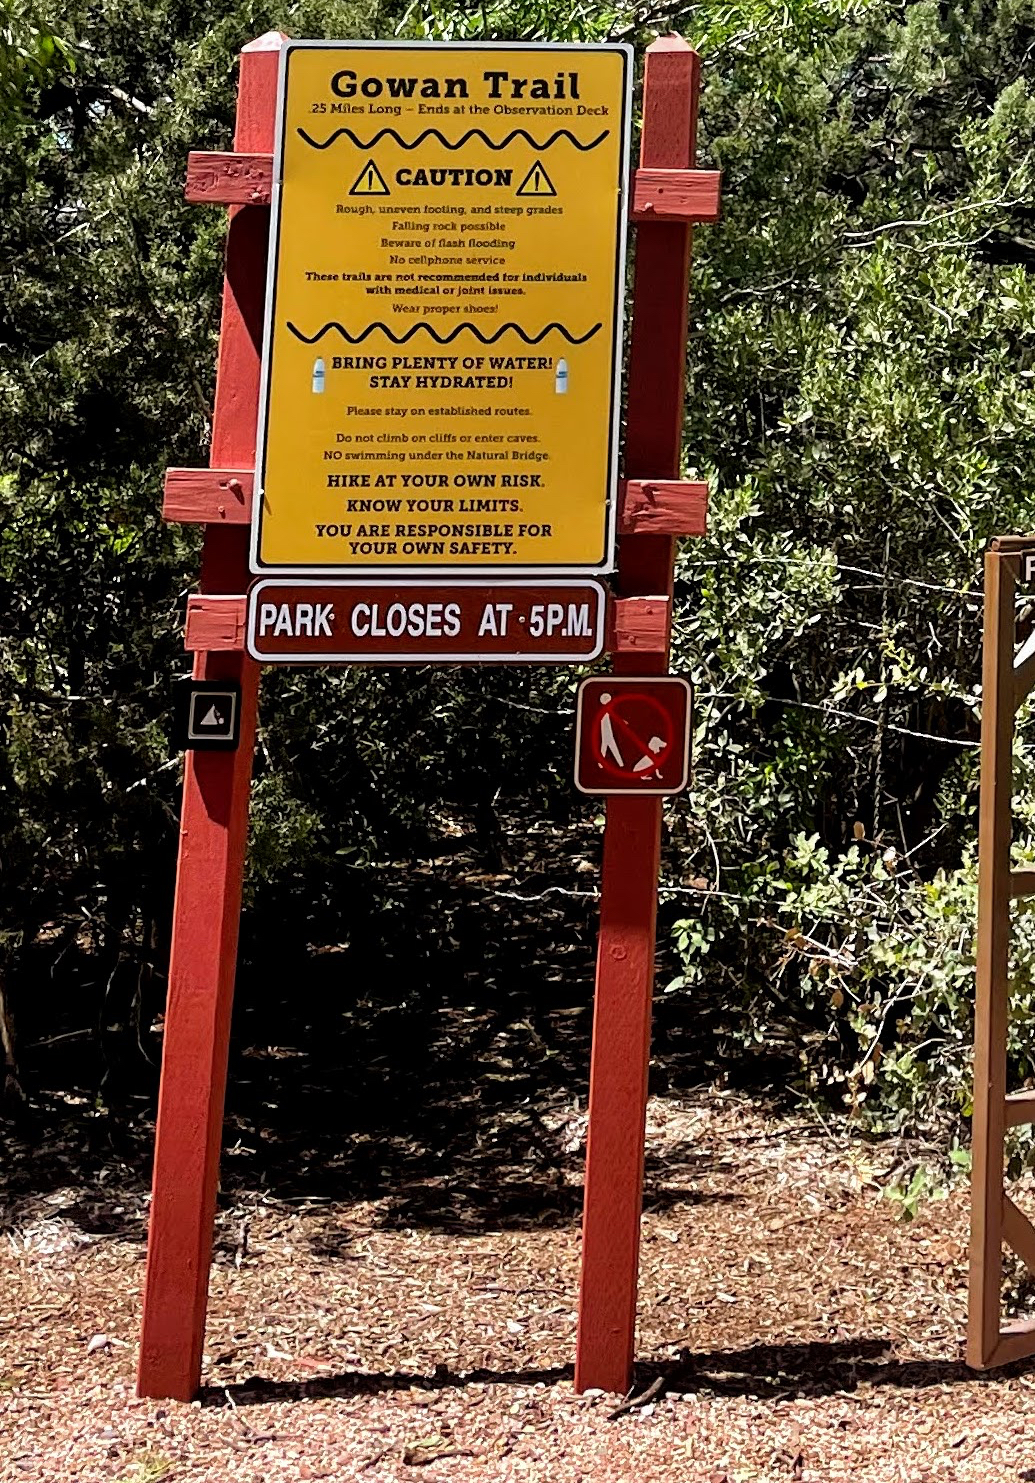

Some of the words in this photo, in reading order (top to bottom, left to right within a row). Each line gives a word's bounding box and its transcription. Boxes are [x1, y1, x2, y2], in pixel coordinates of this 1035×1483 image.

[331, 70, 468, 99] Gowan
[483, 72, 580, 99] Trail
[330, 102, 364, 114] Miles
[368, 103, 401, 117] Long
[418, 103, 449, 115] Ends
[453, 104, 466, 115] at
[469, 103, 490, 115] the
[494, 104, 573, 116] Observation
[576, 104, 609, 116] Deck
[396, 169, 513, 186] CAUTION
[336, 204, 375, 216] Rough,
[379, 206, 420, 215] uneven
[424, 204, 467, 217] footing,
[471, 204, 491, 215] and
[495, 205, 523, 217] steep
[526, 204, 563, 217] grades
[392, 220, 430, 233] Falling
[433, 221, 457, 231] rock
[460, 221, 506, 234] possible
[381, 237, 421, 248] Beware
[424, 238, 436, 248] of
[439, 238, 465, 248] flash
[468, 238, 515, 251] flooding
[390, 254, 405, 265] No
[408, 254, 463, 267] cellphone
[466, 255, 505, 265] service
[306, 271, 338, 282] These
[342, 271, 371, 282] trails
[375, 274, 392, 282] are
[395, 272, 415, 282] not
[418, 272, 499, 282] recommended
[502, 272, 519, 282] for
[522, 272, 587, 282] individuals
[366, 285, 391, 295] with
[394, 285, 440, 295] medical
[443, 287, 454, 295] or
[457, 285, 485, 298] joint
[488, 285, 526, 296] issues.
[392, 303, 419, 314] Wear
[423, 305, 460, 316] proper
[464, 303, 498, 314] shoes!
[332, 356, 387, 370] BRING
[391, 356, 458, 370] PLENTY
[462, 356, 484, 370] OF
[489, 356, 552, 370] WATER!
[369, 375, 410, 389] STAY
[415, 375, 513, 389] HYDRATED!
[346, 405, 382, 416] Please
[385, 406, 408, 418] stay
[410, 408, 425, 416] on
[428, 406, 491, 416] established
[336, 433, 352, 443] Do
[355, 434, 374, 443] not
[377, 433, 409, 443] climb
[411, 435, 426, 443] on
[429, 433, 457, 443] cliffs
[459, 435, 472, 443] or
[475, 433, 503, 443] enter
[324, 450, 342, 461] NO
[345, 450, 405, 463] swimming
[408, 450, 443, 461] under
[446, 450, 463, 461] the
[467, 450, 508, 461] Natural
[327, 475, 371, 487] HIKE
[375, 475, 398, 487] AT
[401, 475, 449, 487] YOUR
[453, 475, 498, 487] OWN
[501, 475, 545, 487] RISK.
[346, 500, 404, 512] KNOW
[407, 500, 454, 512] YOUR
[458, 500, 524, 512] LIMITS.
[315, 525, 352, 537] YOU
[356, 525, 390, 537] ARE
[394, 525, 514, 537] RESPONSIBLE
[517, 525, 552, 537] FOR
[350, 542, 398, 554] YOUR
[402, 542, 445, 554] OWN
[449, 542, 517, 554] SAFETY.
[260, 603, 334, 637] PARK
[351, 603, 461, 637] CLOSES
[478, 603, 513, 637] AT
